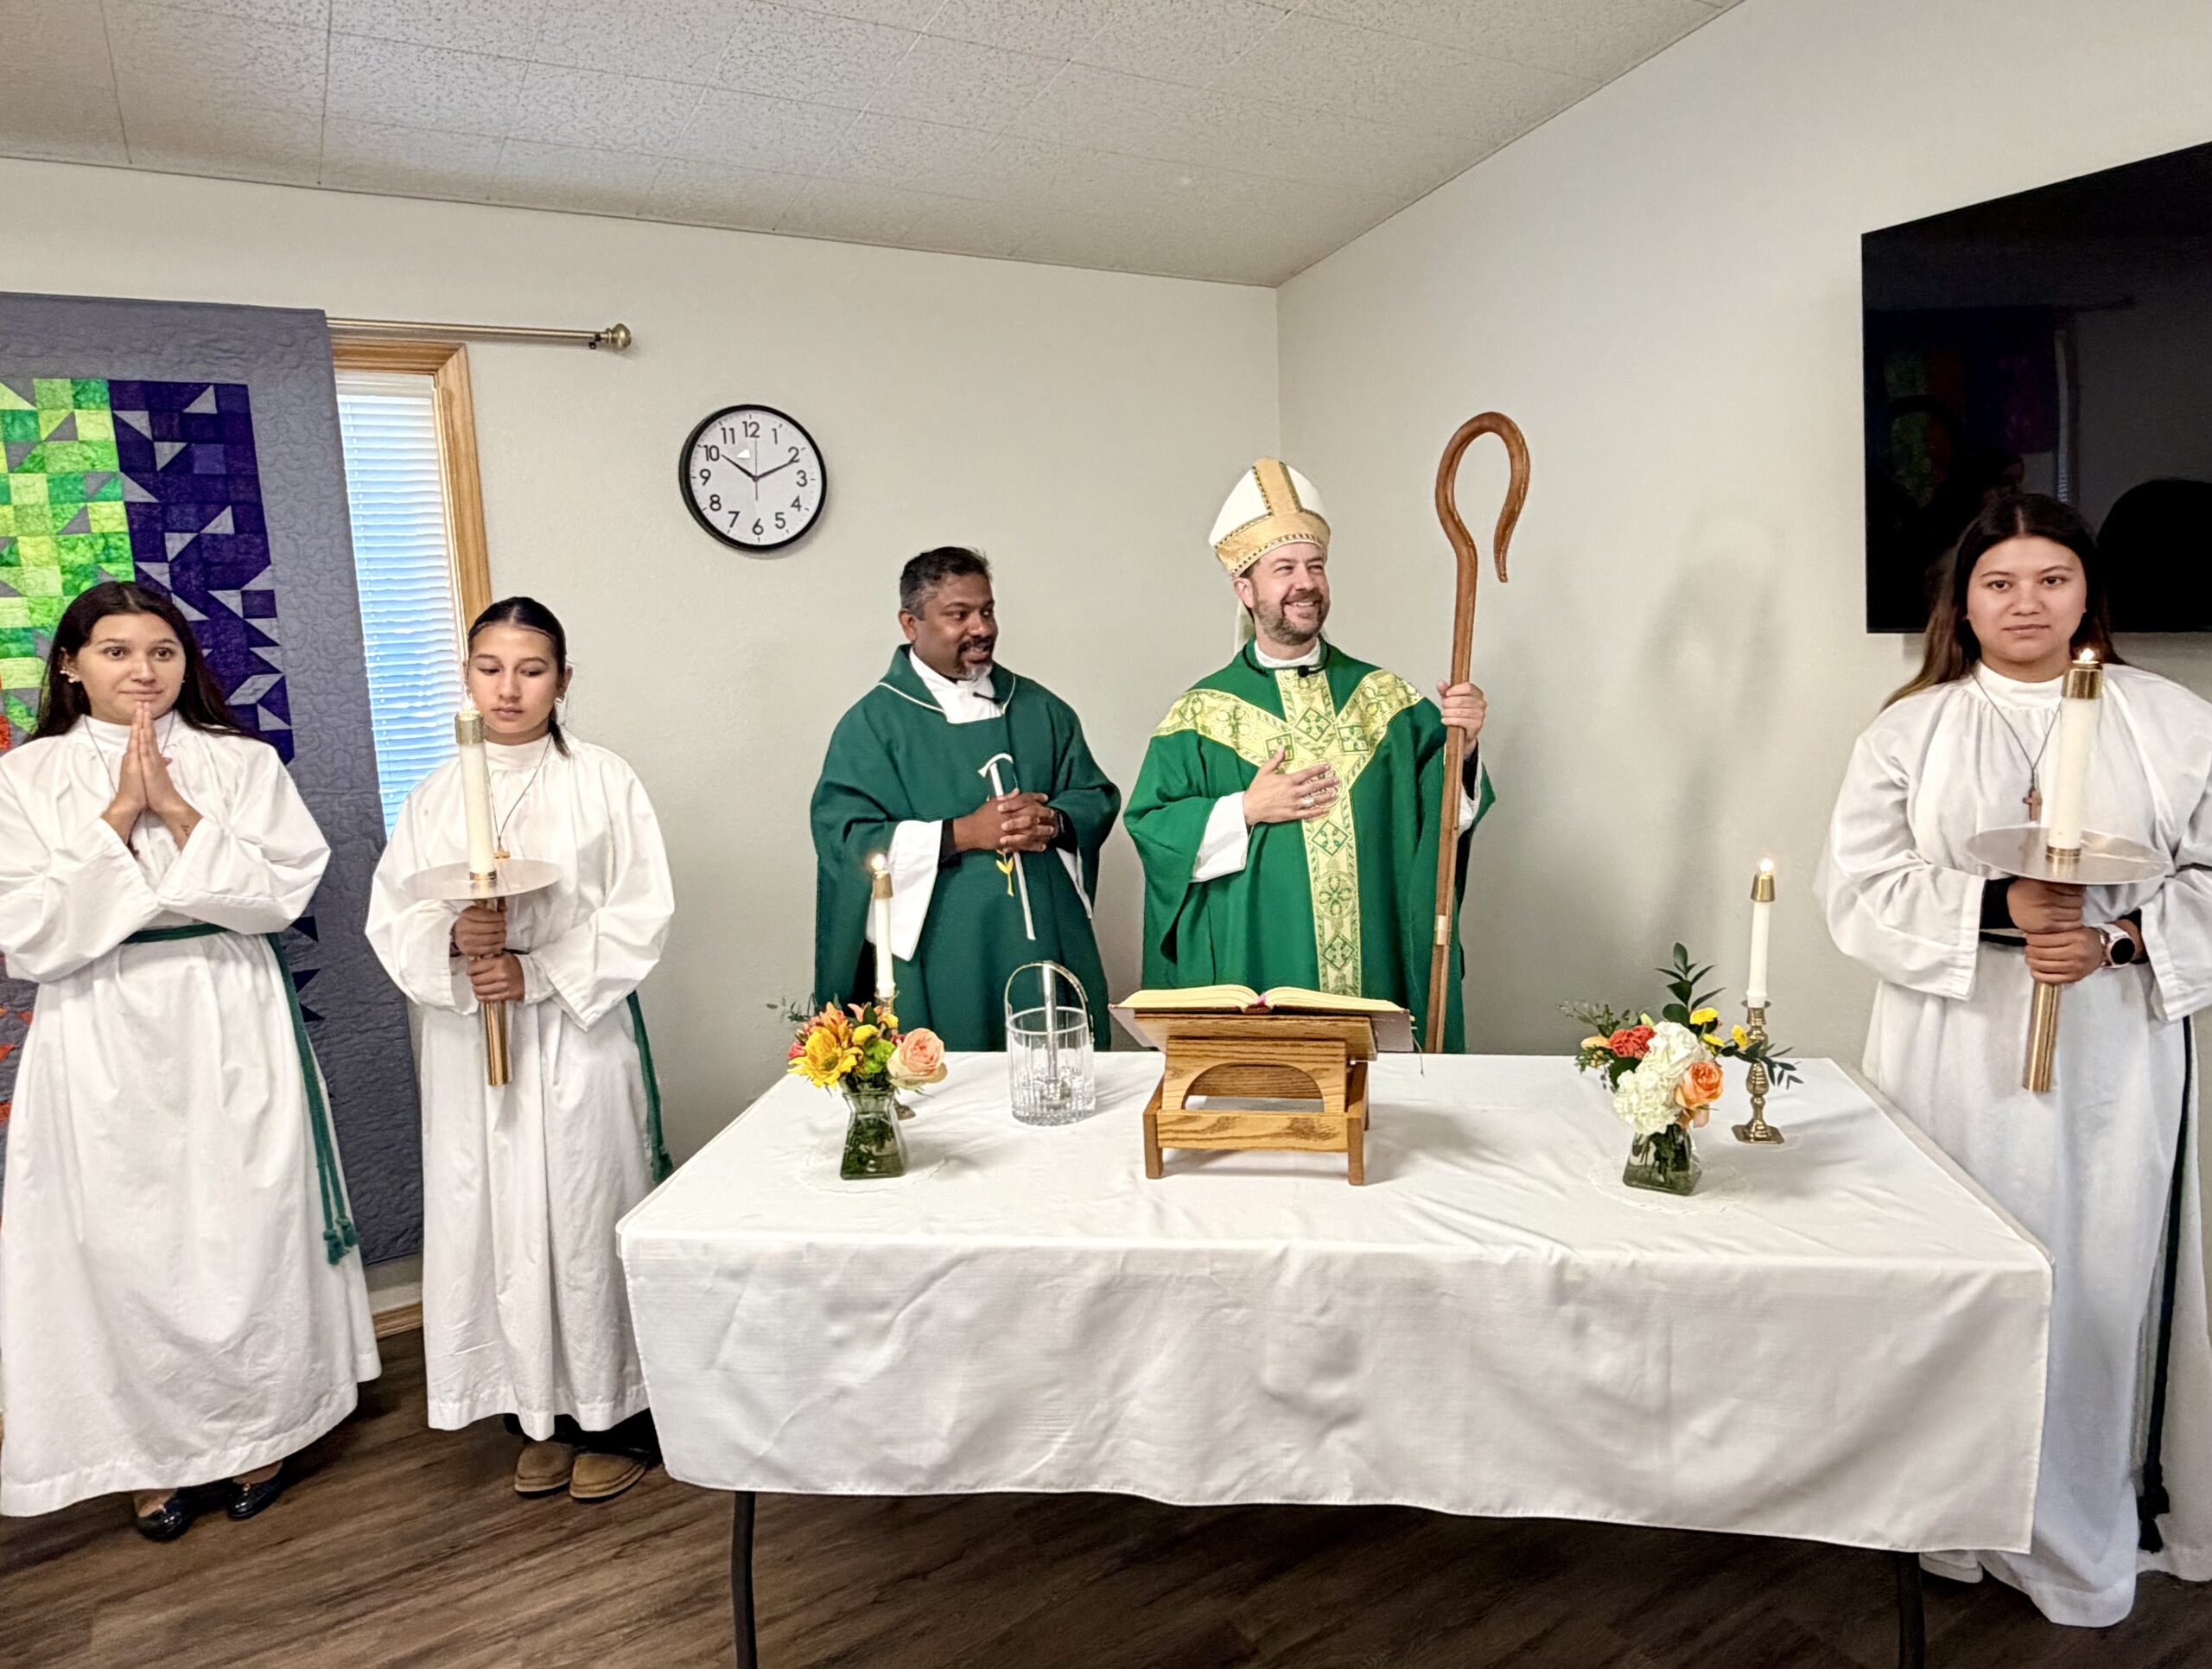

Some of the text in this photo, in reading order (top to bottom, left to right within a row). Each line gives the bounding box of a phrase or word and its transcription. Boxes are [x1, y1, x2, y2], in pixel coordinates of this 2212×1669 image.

[721, 427, 735, 444] 11
[742, 422, 760, 437] 12
[772, 429, 778, 444] 1
[703, 445, 720, 462] 10
[788, 447, 799, 462] 2
[700, 469, 711, 486] 9
[796, 470, 807, 487] 3
[709, 494, 721, 511] 8
[790, 495, 802, 512] 4
[728, 511, 740, 527] 7
[753, 518, 764, 535] 6
[775, 513, 785, 529] 5
